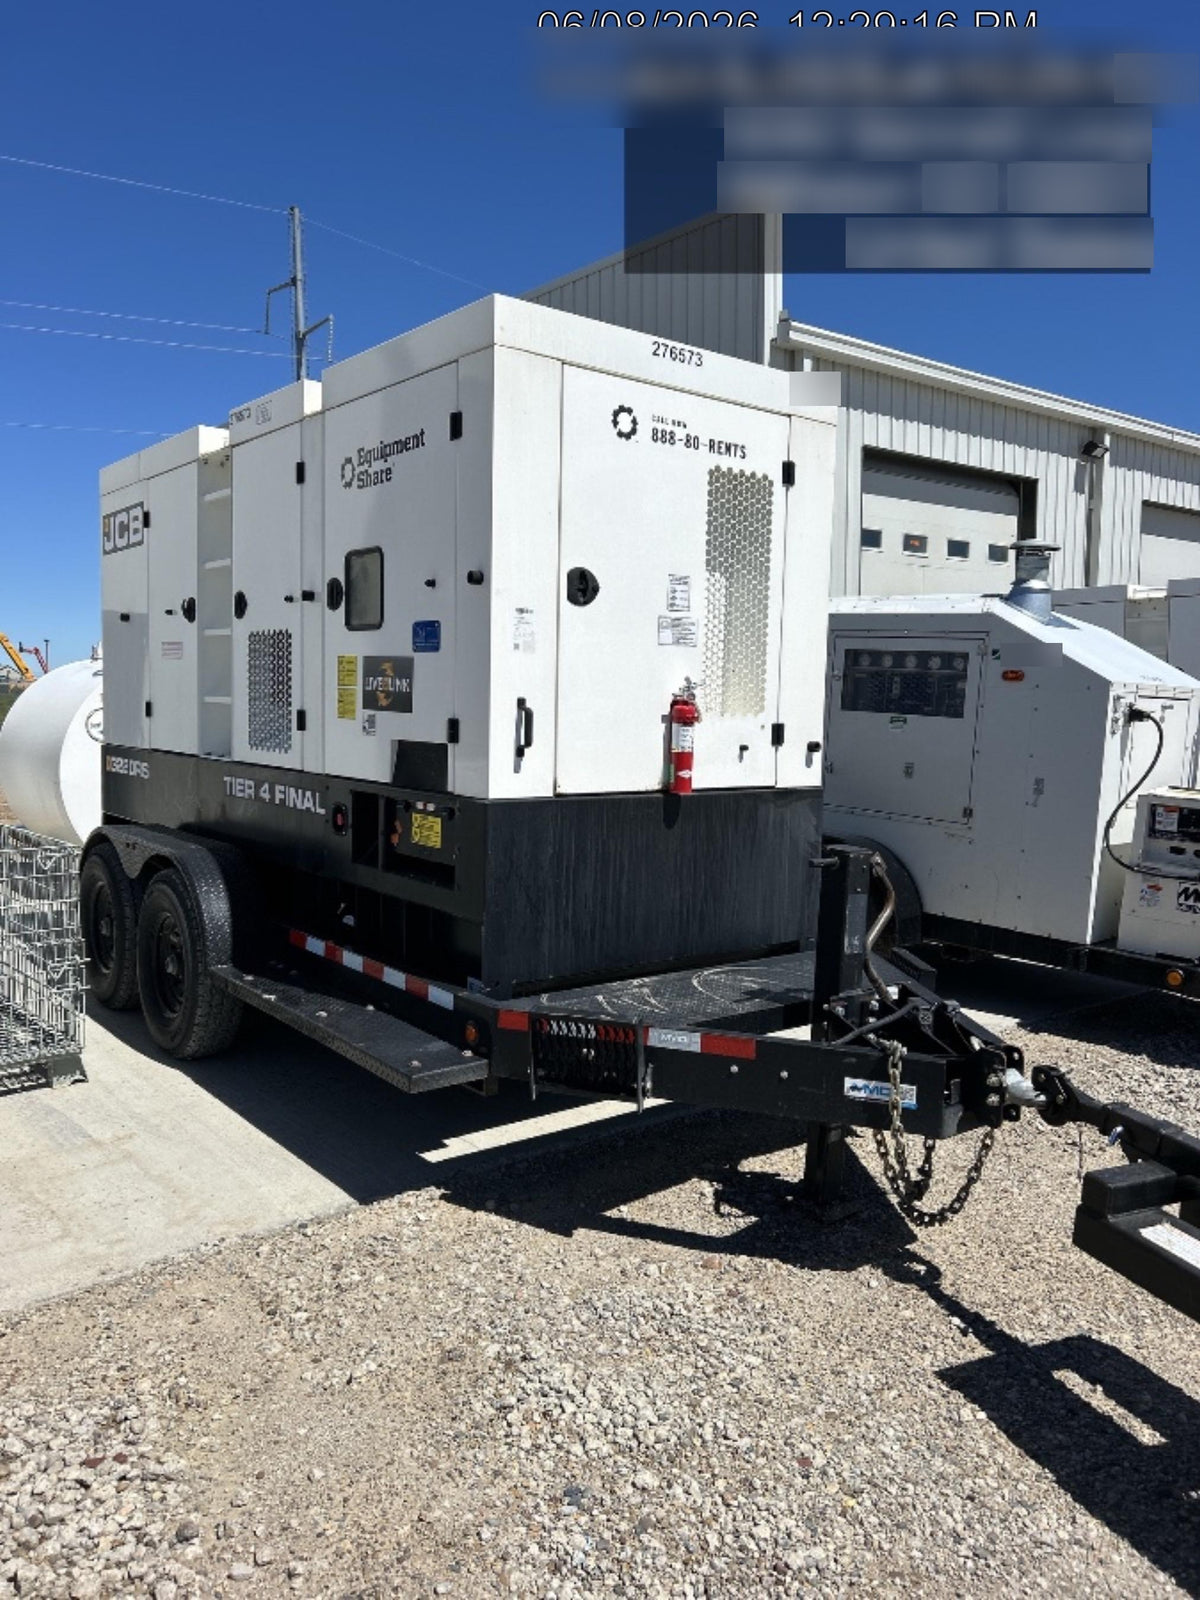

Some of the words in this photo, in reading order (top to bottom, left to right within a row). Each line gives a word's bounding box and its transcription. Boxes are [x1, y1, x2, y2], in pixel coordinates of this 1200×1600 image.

[652, 340, 703, 367] 276573
[357, 428, 425, 468] Equipment
[651, 427, 746, 460] 888-80-RENTS
[357, 467, 392, 489] Share
[103, 504, 144, 552] JCB
[223, 776, 255, 800] TIER
[260, 782, 271, 803] 4
[275, 784, 326, 815] FINAL
